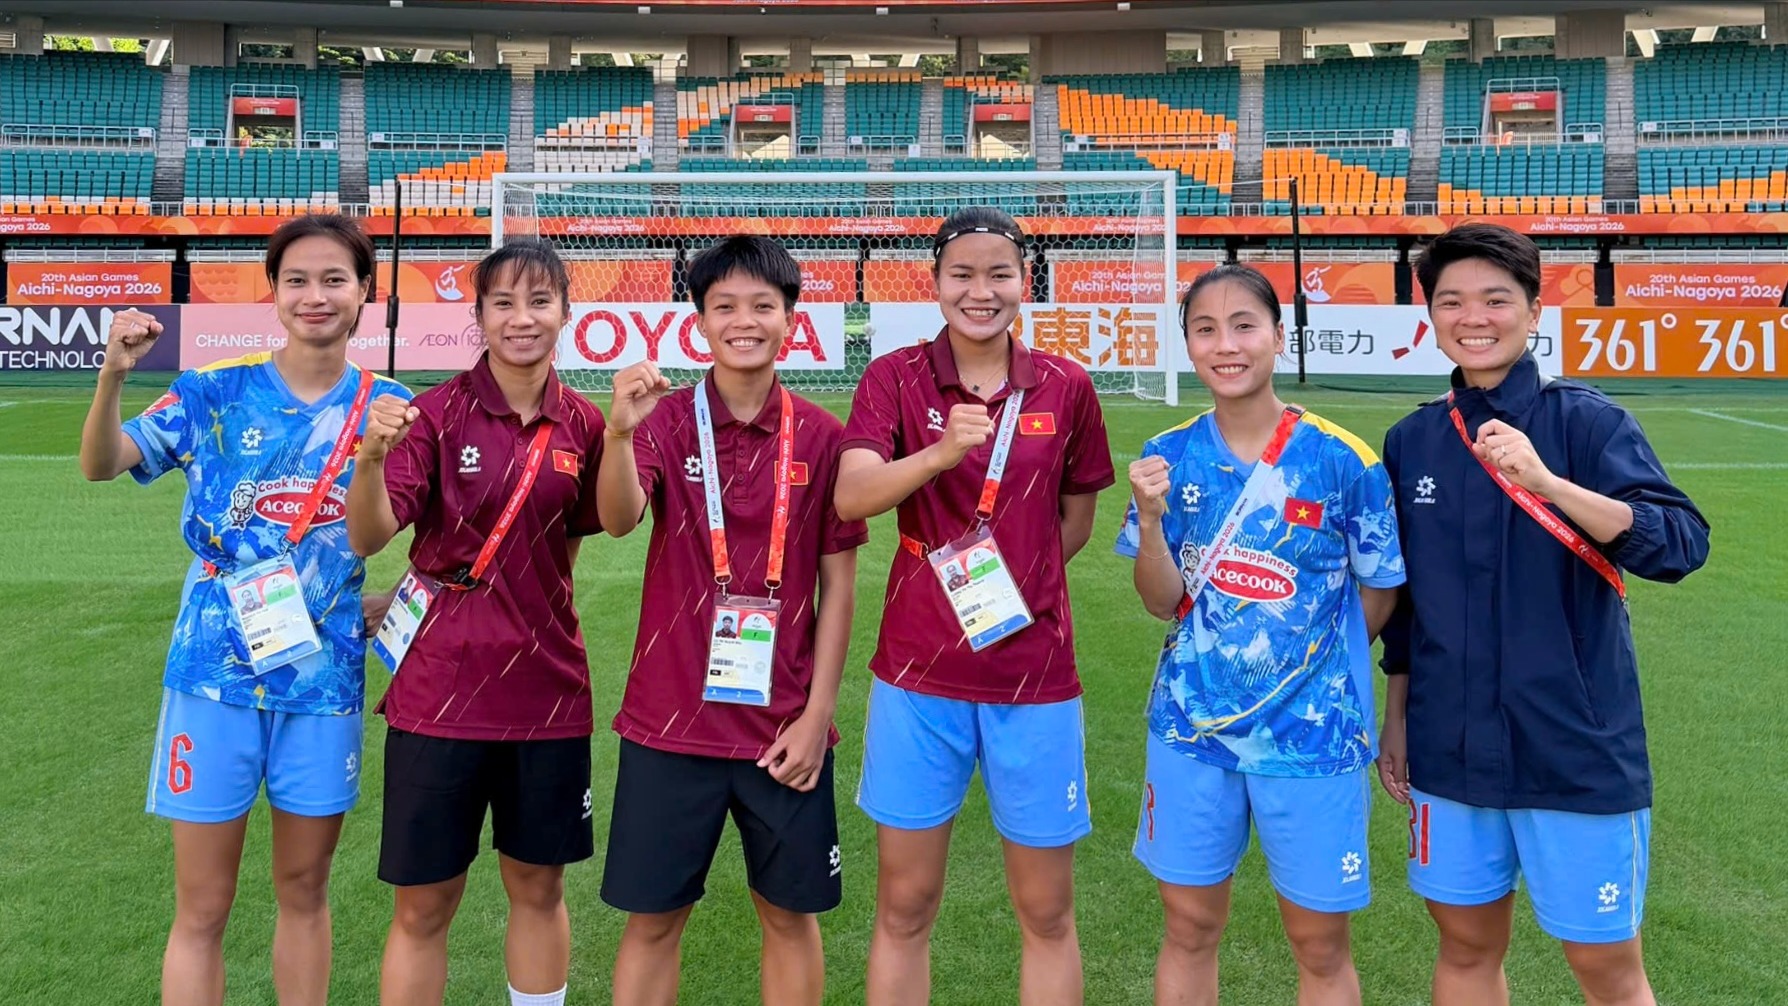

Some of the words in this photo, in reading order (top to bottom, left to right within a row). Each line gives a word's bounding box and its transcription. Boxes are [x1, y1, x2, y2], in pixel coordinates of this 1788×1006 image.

[27, 223, 51, 232] 2026
[622, 224, 645, 232] 2026
[884, 224, 906, 232] 2026
[1530, 222, 1597, 232] Aichi-Nagoya
[1599, 222, 1625, 231] 2026
[41, 273, 66, 282] 20th
[69, 273, 98, 282] Asian
[101, 273, 139, 282] Games
[1649, 275, 1676, 284] 20th
[1679, 275, 1709, 284] Asian
[1712, 275, 1755, 284] Games
[17, 283, 121, 298] Aichi-Nagoya
[125, 283, 162, 295] 2026
[802, 280, 834, 291] 2026
[1072, 281, 1162, 294] Aichi-Nagoya
[1625, 285, 1737, 300] Aichi-Nagoya
[1741, 285, 1782, 298] 2026
[196, 334, 263, 348] CHANGE
[267, 334, 286, 348] for
[349, 334, 410, 350] ogether.
[552, 310, 827, 364] OYOA
[1014, 307, 1159, 367] 東海
[1289, 329, 1374, 356] 部電力
[0, 351, 107, 369] TECHNOLO
[258, 477, 289, 493] Cook
[293, 477, 346, 497] hapes
[779, 482, 788, 500] 2026
[1515, 491, 1557, 529] Aichi-Nagoya
[1556, 525, 1575, 543] 2026
[1222, 521, 1236, 539] 2026
[1234, 546, 1297, 576] happiness
[167, 732, 194, 795] 6
